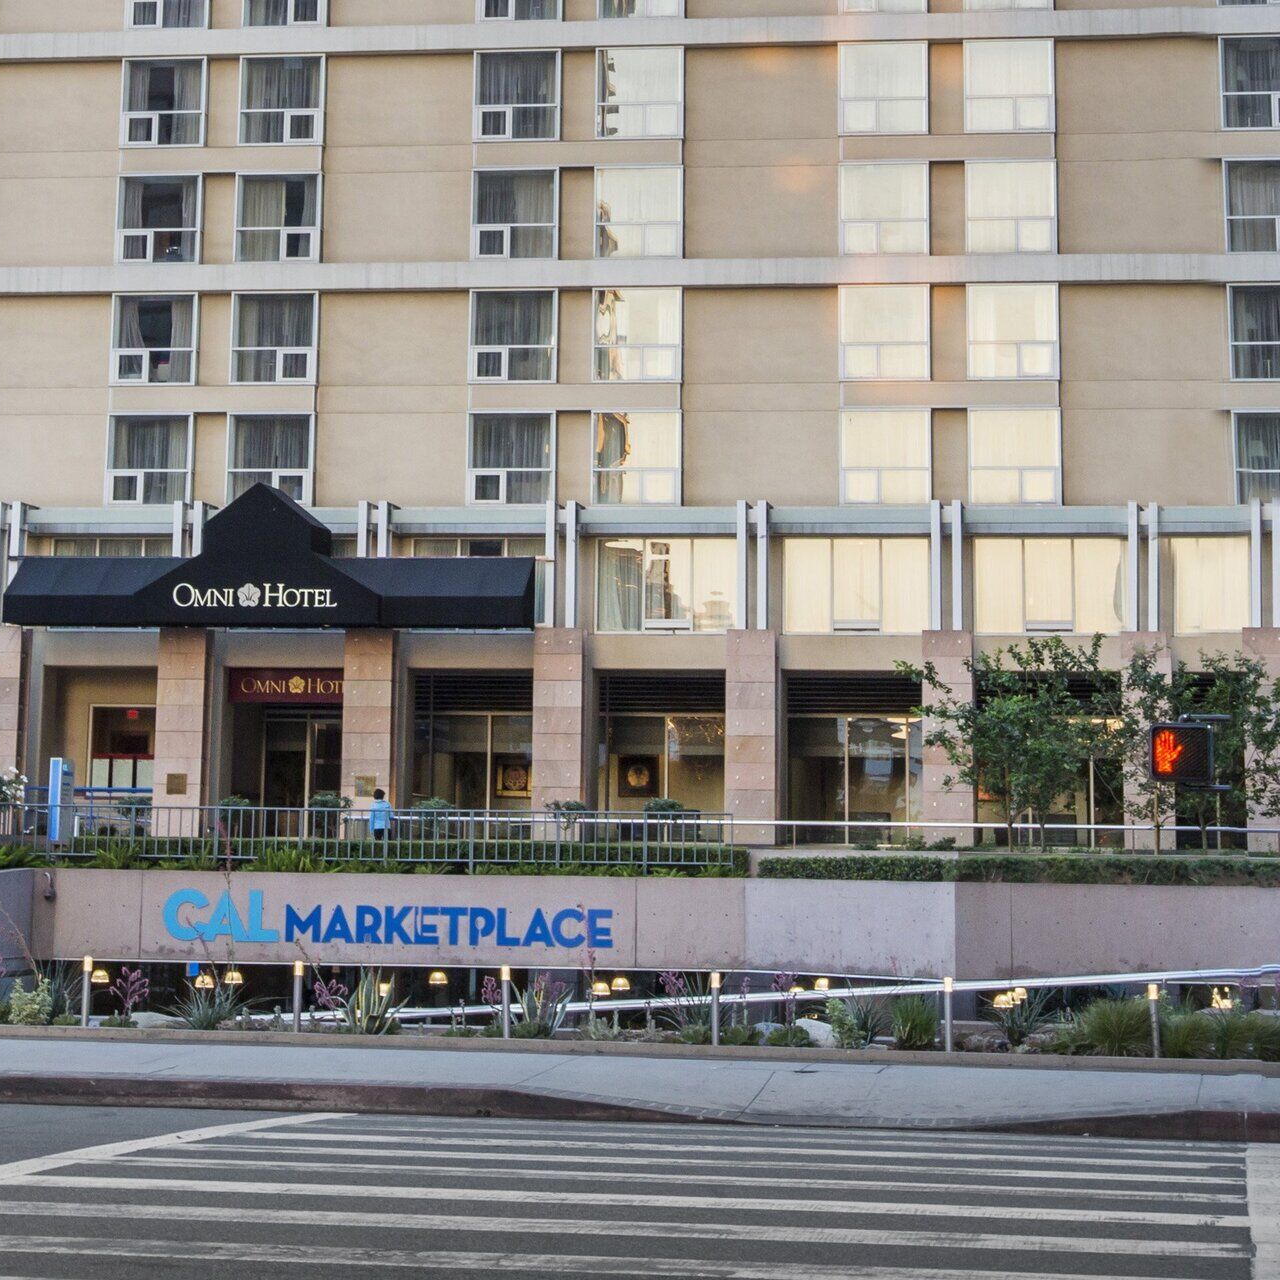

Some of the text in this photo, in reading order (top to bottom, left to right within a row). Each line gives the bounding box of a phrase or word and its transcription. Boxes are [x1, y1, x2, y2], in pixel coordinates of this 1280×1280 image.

[172, 582, 338, 608] OMNI HOTEL
[241, 677, 344, 694] OMNI HOT
[162, 888, 614, 949] CAL MARKETPLACE
